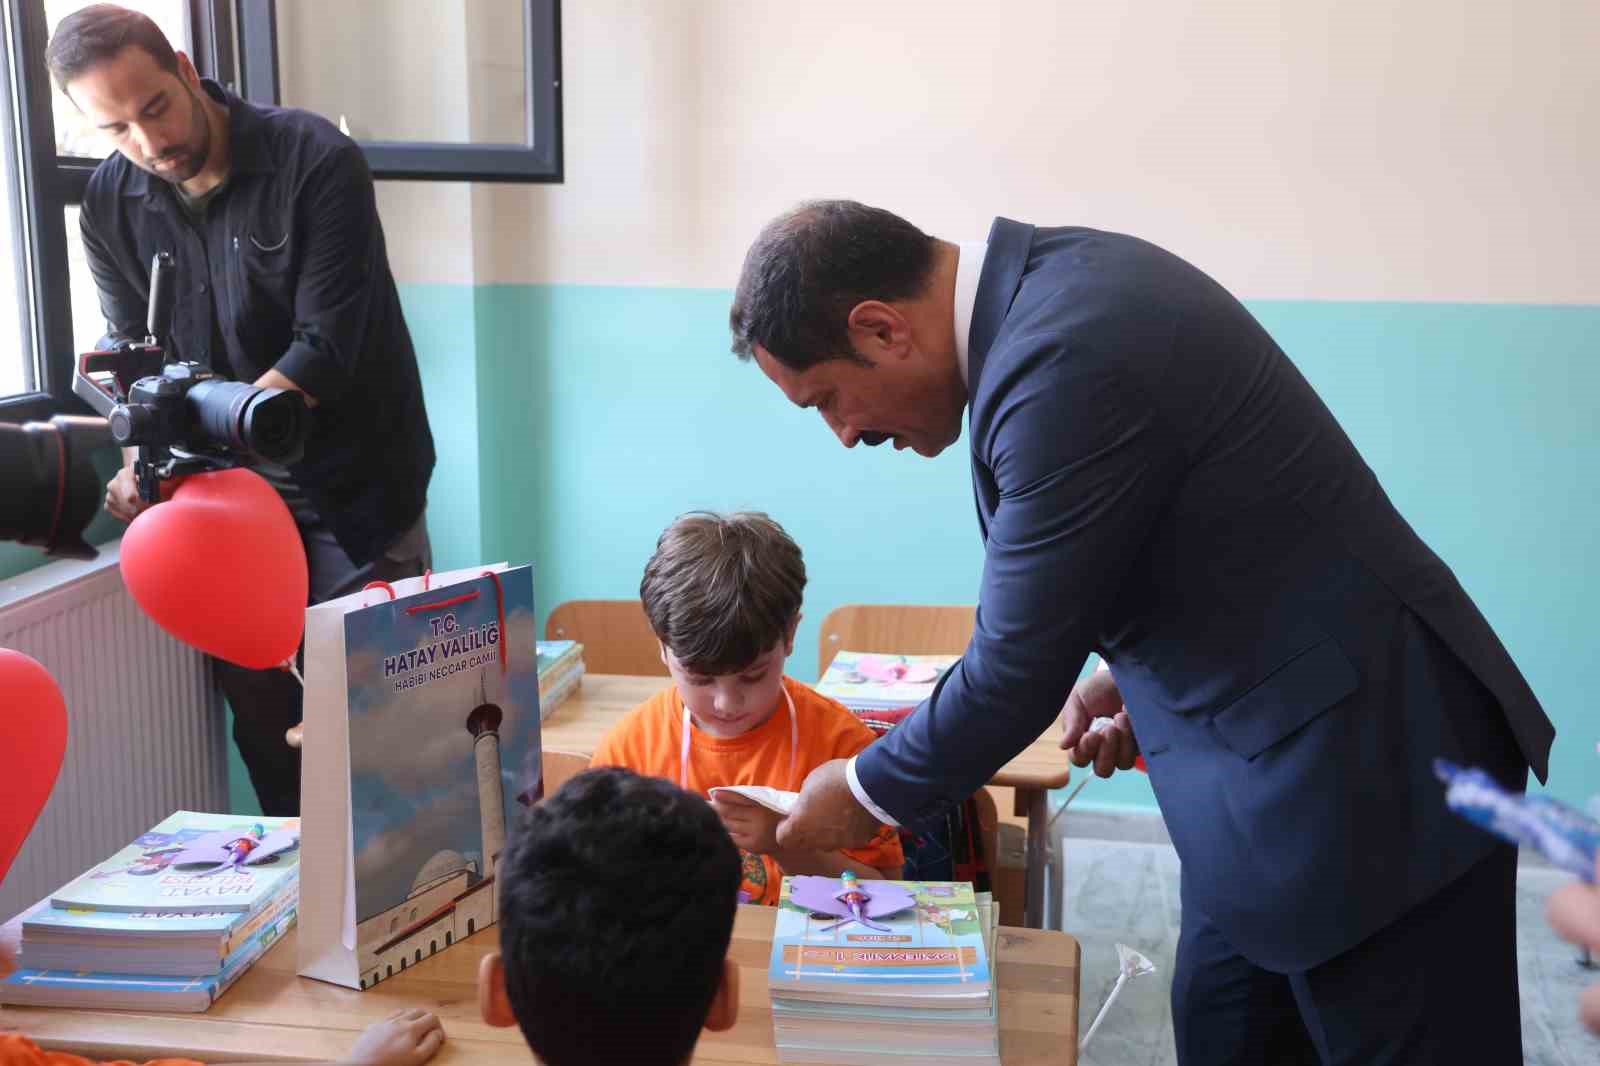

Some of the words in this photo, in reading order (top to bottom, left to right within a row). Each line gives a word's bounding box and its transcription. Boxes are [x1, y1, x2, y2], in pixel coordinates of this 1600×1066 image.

[430, 614, 459, 636] T.C.
[384, 644, 437, 677] HATAY
[441, 622, 498, 658] VALİLİĞ
